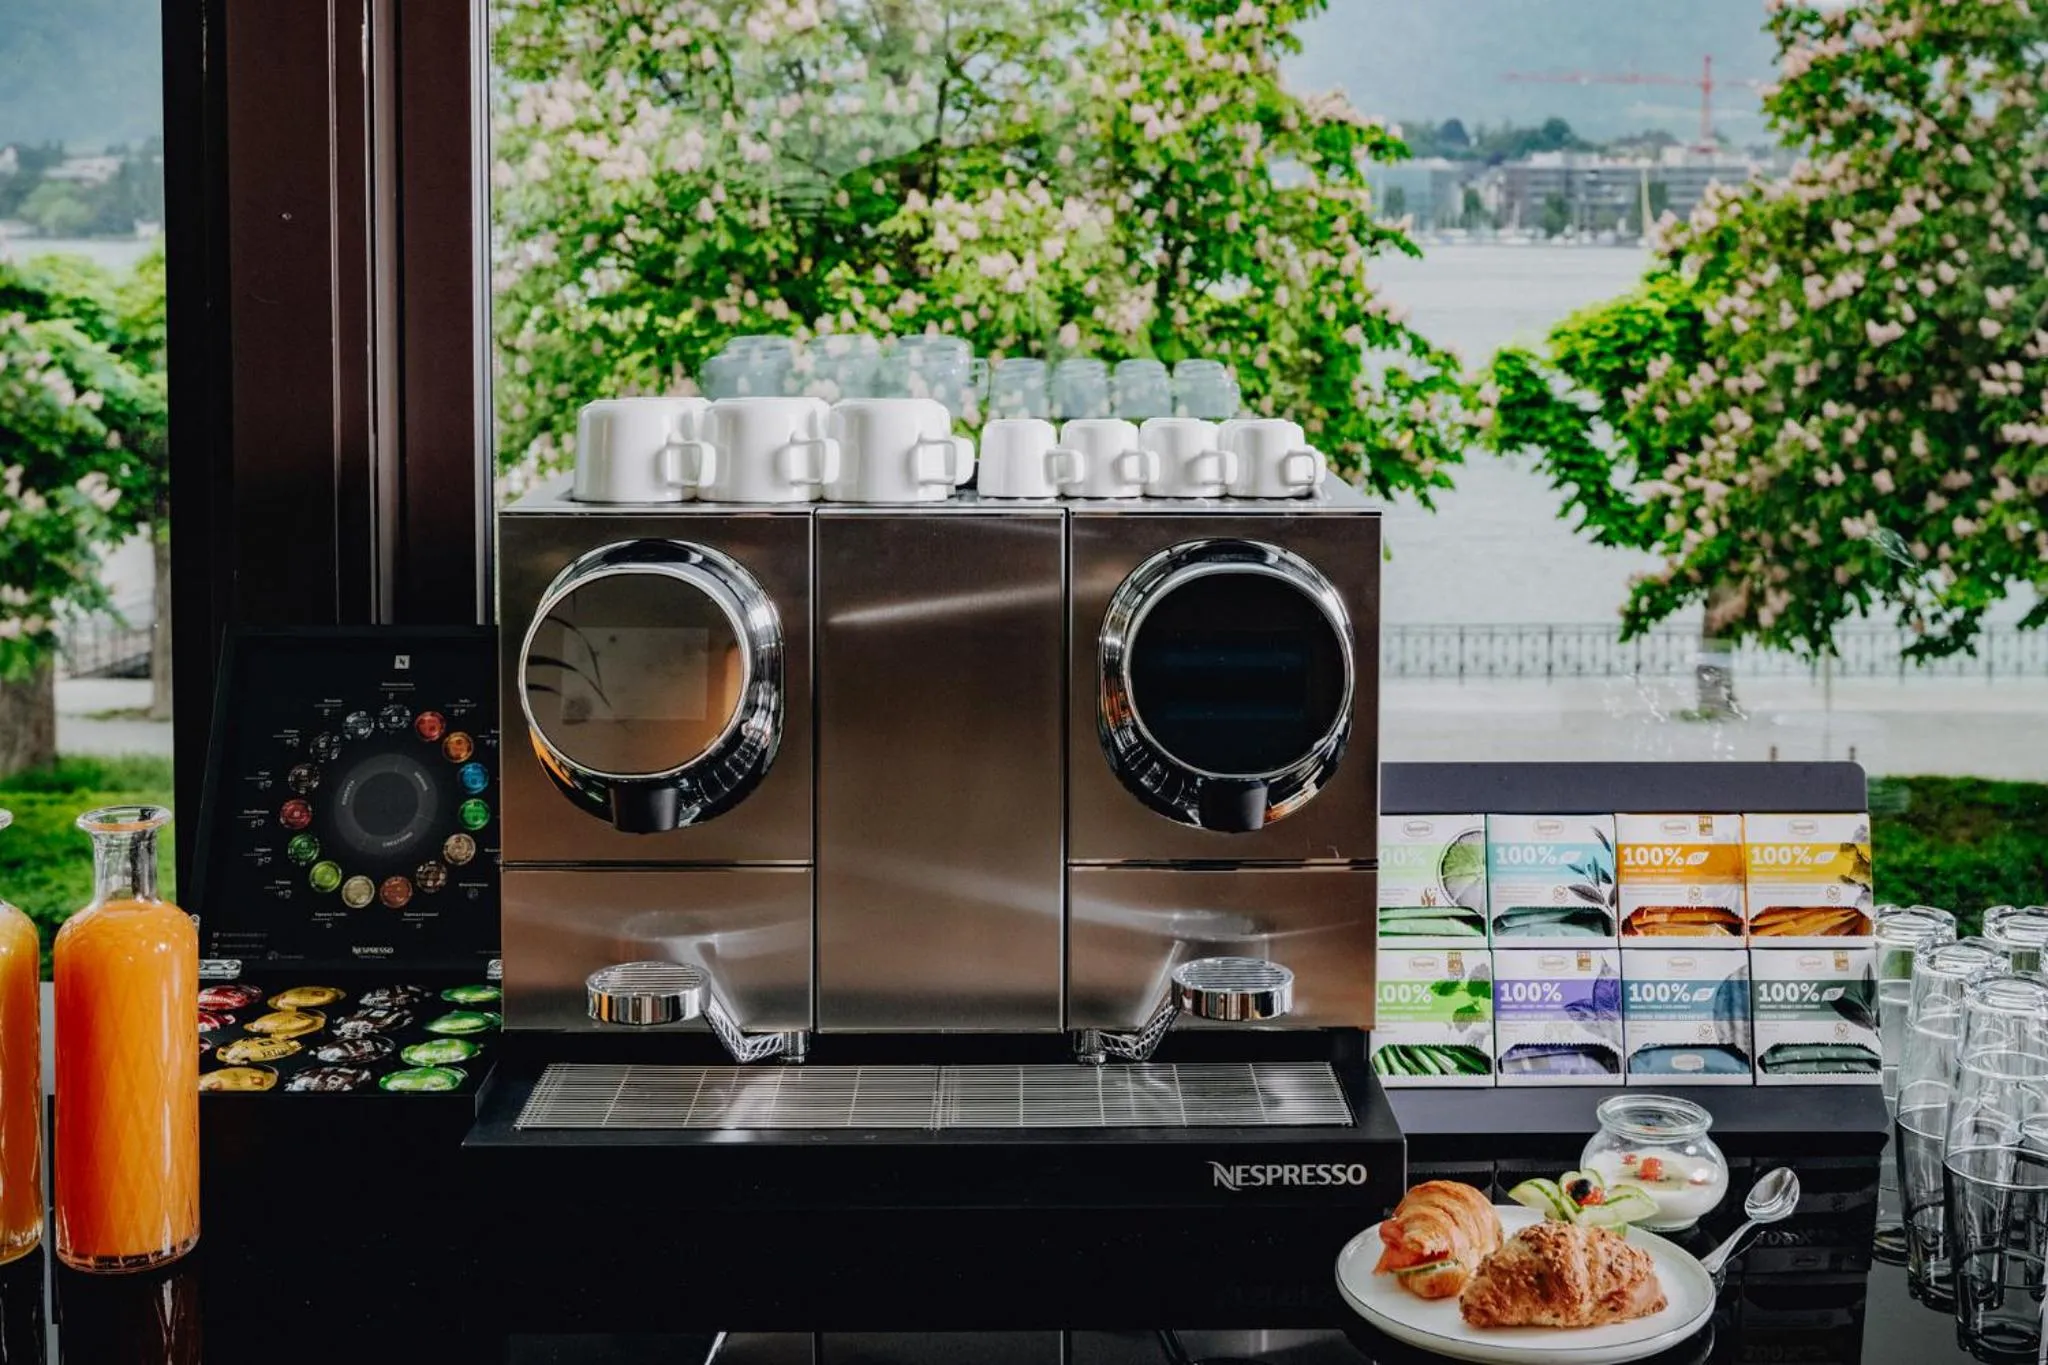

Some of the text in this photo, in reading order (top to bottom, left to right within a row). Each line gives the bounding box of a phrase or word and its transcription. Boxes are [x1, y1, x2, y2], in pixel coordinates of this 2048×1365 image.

[1380, 847, 1427, 866] 00%
[1496, 846, 1557, 865] 100%
[1623, 846, 1684, 866] 100%
[1750, 846, 1813, 865] 100%
[1500, 982, 1562, 1002] 100%
[1628, 982, 1691, 1002] 100%
[1758, 982, 1821, 1003] 100%
[1204, 1160, 1368, 1191] NESPRESSO
